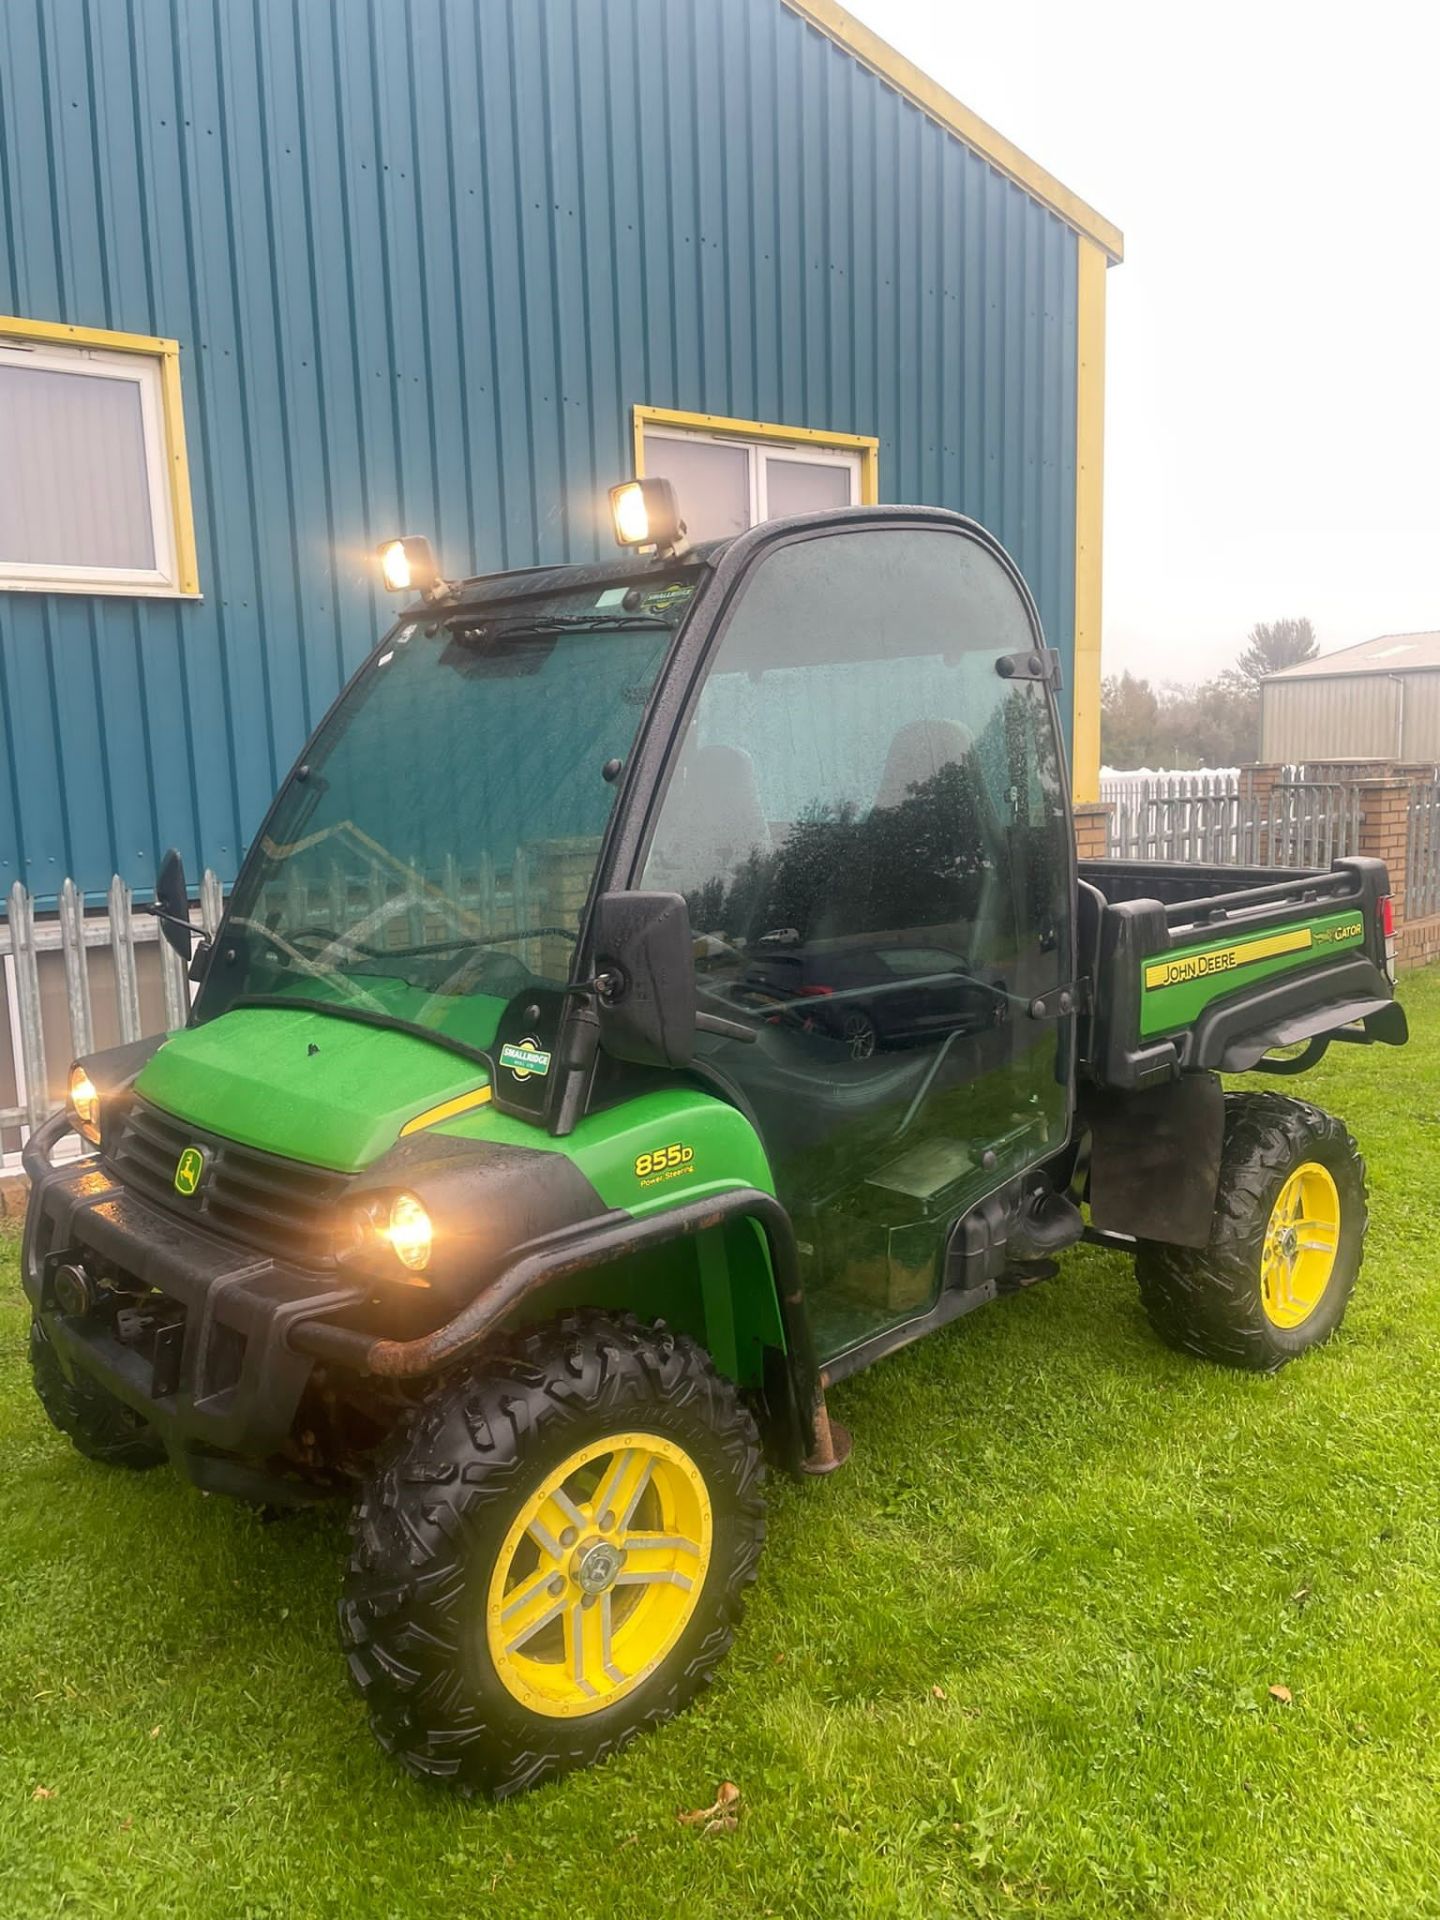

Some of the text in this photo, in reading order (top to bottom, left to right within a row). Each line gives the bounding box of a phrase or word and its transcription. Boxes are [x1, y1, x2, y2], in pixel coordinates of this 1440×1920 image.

[1334, 923, 1361, 941] GATOR
[1163, 952, 1236, 983] JOHN DEERE
[503, 1047, 548, 1065] SMALLRIDGE
[635, 1144, 693, 1176] 855D
[640, 1176, 663, 1187] Power
